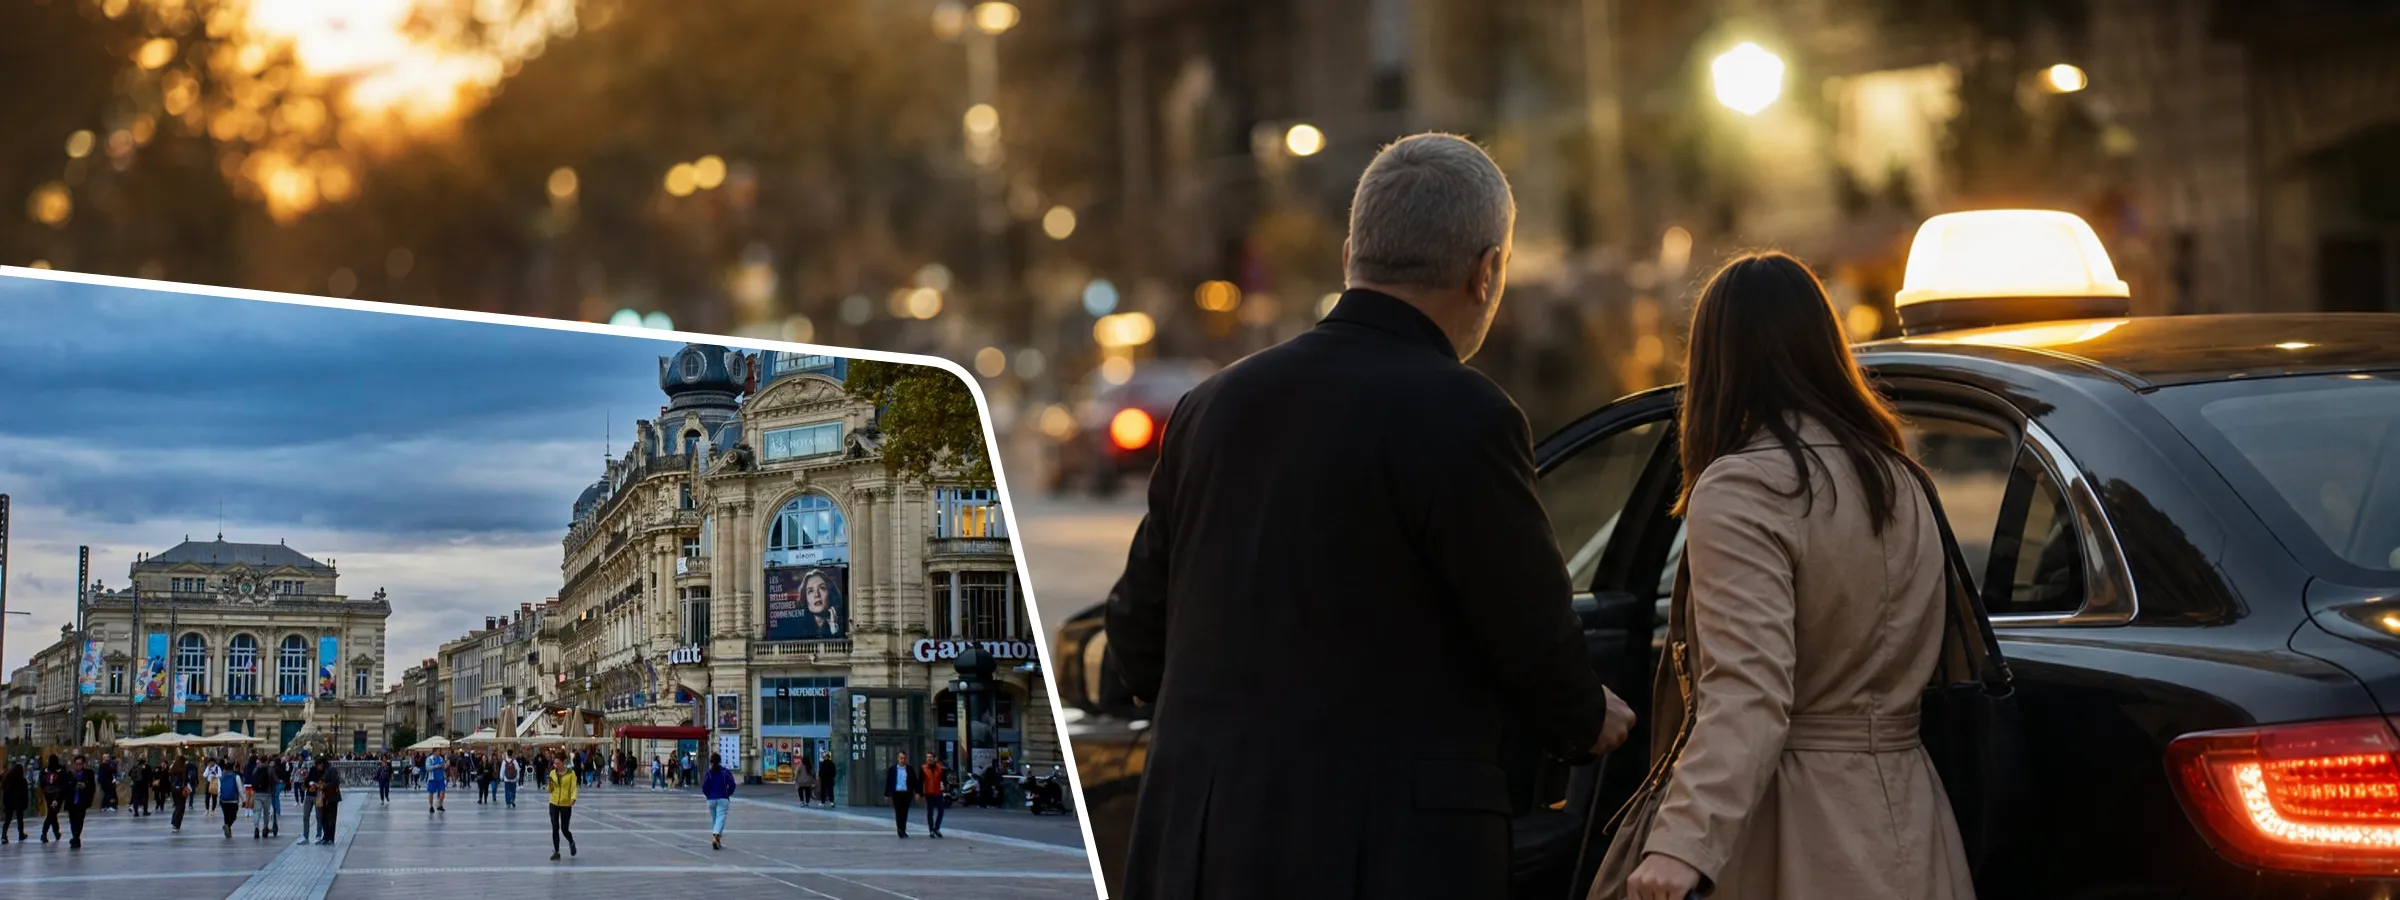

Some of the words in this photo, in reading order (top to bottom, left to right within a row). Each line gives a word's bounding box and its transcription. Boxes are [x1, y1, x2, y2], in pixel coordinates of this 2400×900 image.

[769, 576, 779, 584] LES
[769, 584, 783, 593] PLUS
[769, 593, 788, 601] BELLES
[769, 601, 796, 610] HISTOIRES
[769, 609, 805, 619] COMMENCENT
